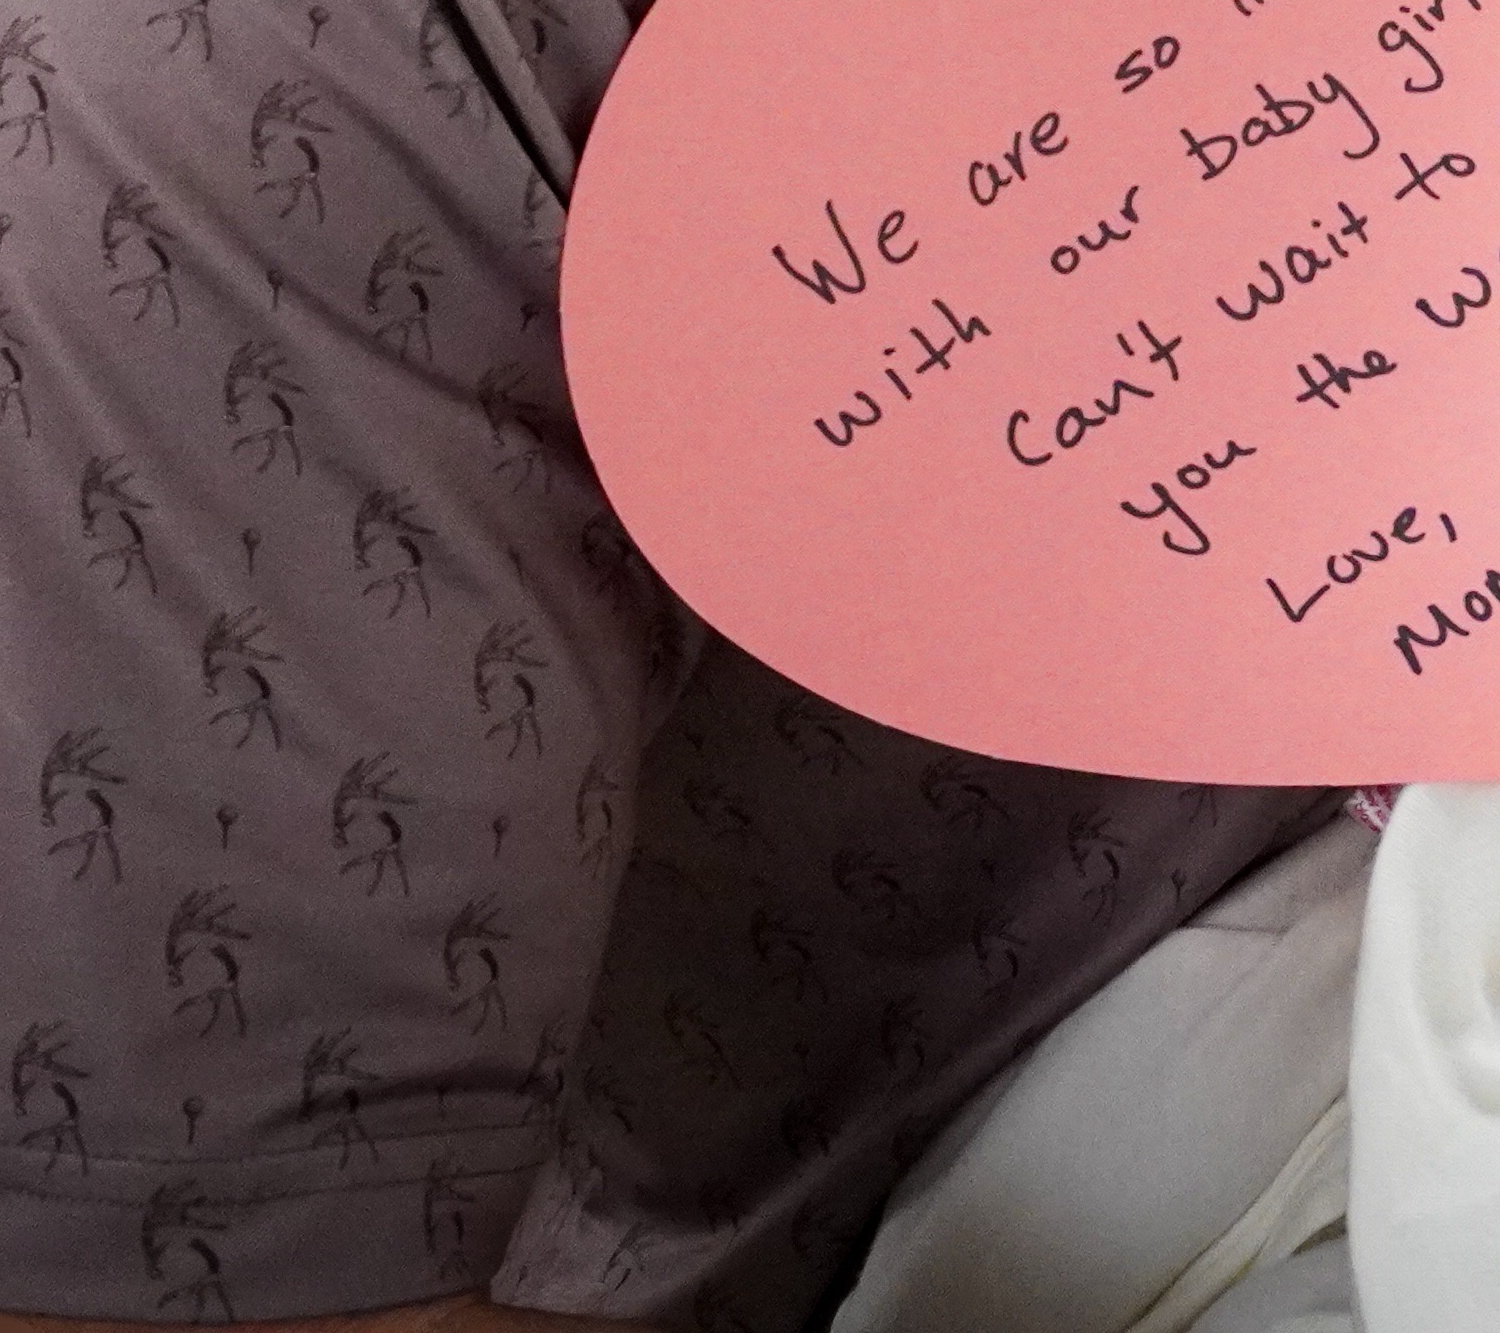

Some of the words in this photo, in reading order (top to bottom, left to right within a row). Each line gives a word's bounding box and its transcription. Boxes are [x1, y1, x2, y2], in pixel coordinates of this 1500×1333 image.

[771, 199, 919, 305] We
[968, 111, 1069, 207] are
[1114, 35, 1181, 94] so
[813, 298, 992, 447] with
[1050, 185, 1141, 275] our
[1179, 72, 1381, 182] baby
[1006, 320, 1182, 467] Can't
[1215, 200, 1369, 322] wait
[1394, 152, 1476, 201] to
[1119, 439, 1258, 556] you
[1295, 350, 1398, 409] the
[1265, 506, 1458, 624] Love,
